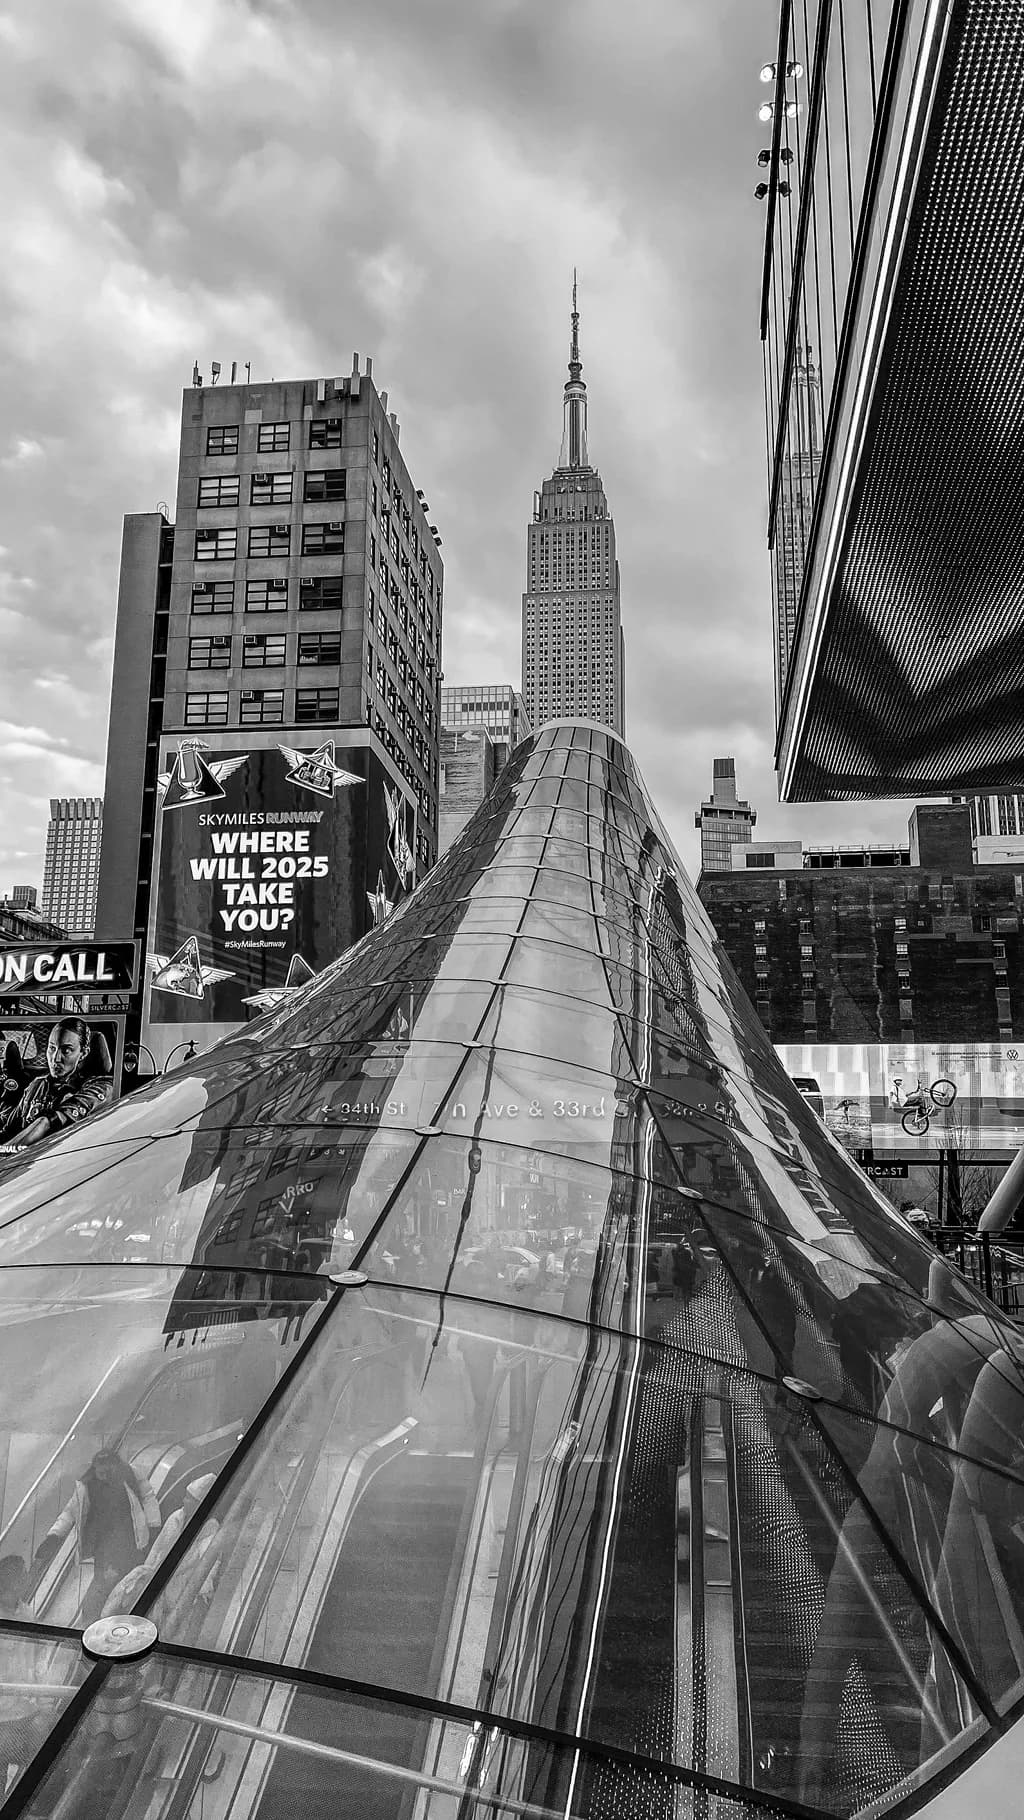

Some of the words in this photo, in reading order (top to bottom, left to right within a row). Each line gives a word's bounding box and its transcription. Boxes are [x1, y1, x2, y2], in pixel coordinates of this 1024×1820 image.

[199, 813, 265, 826] SKYMILES
[266, 811, 324, 824] RUNWAY
[211, 830, 310, 854] WHERE
[189, 857, 256, 881] WILL
[261, 856, 329, 879] 2025
[222, 882, 294, 906] TAKE
[219, 908, 295, 932] YOU?
[224, 940, 287, 949] #SkyMilesRunway
[33, 952, 114, 983] CALL
[340, 1101, 380, 1116] 34th
[387, 1101, 405, 1116] St
[528, 1101, 544, 1117] &
[552, 1098, 606, 1118] 33rd
